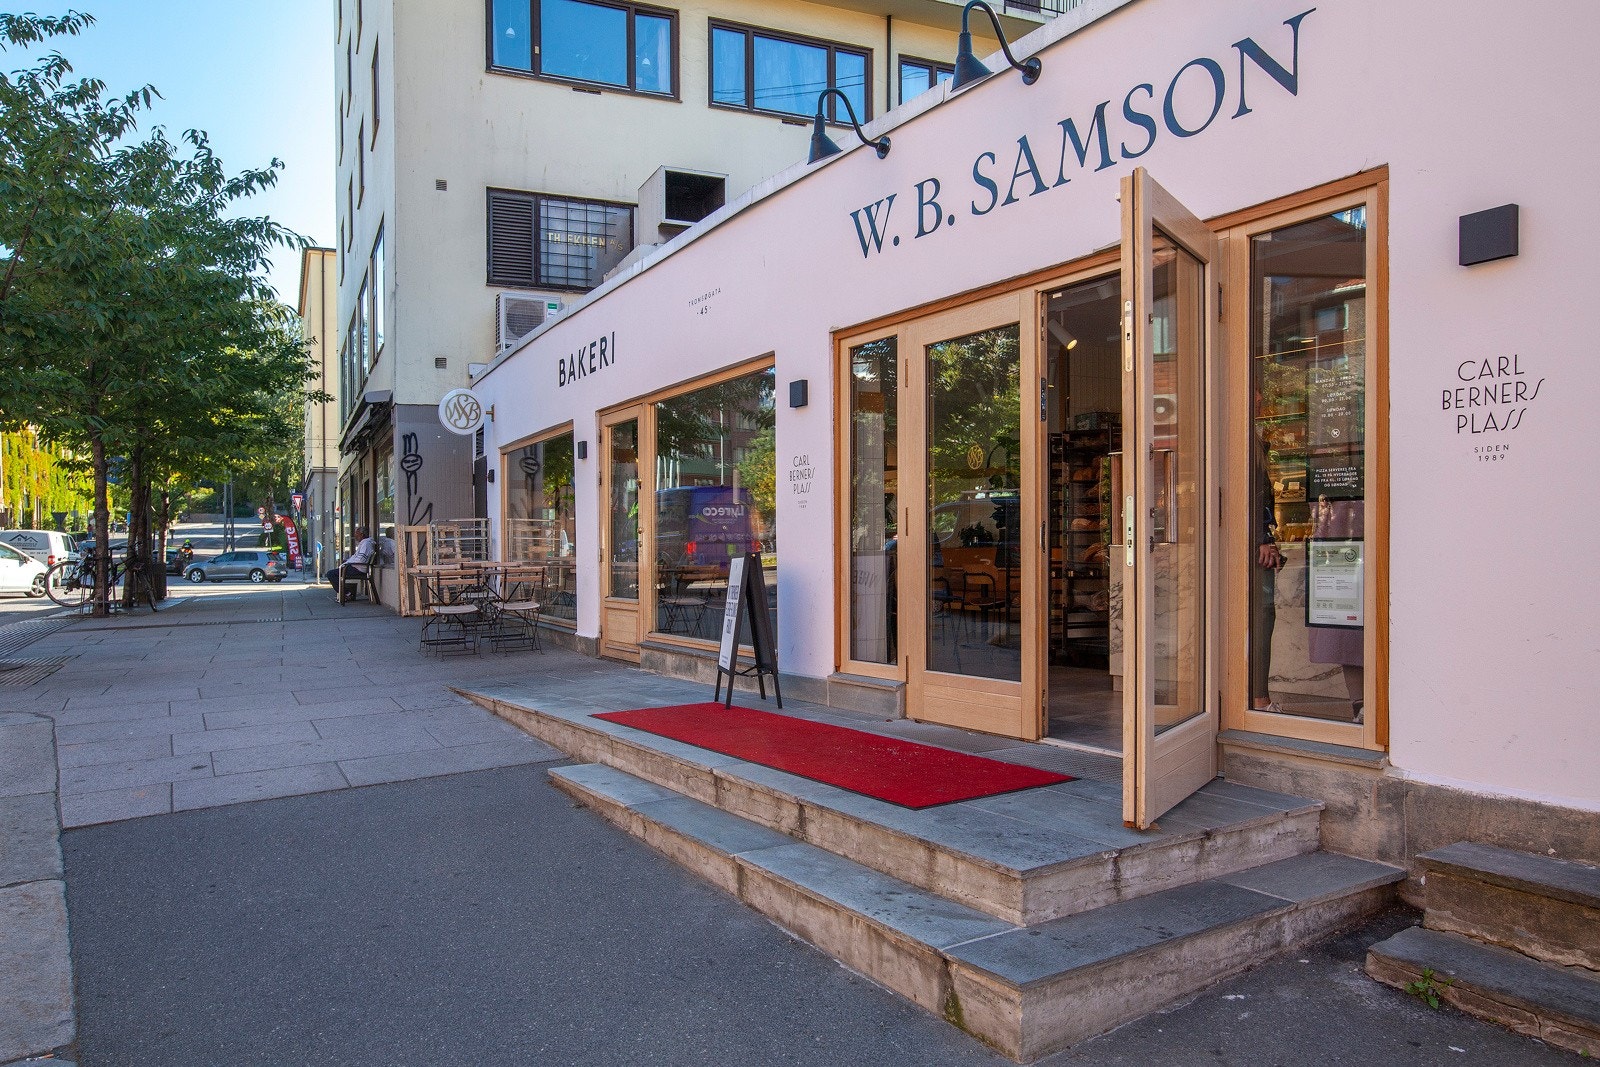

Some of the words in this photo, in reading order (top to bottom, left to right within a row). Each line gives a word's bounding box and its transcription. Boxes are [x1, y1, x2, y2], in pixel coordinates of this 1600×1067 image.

[849, 192, 901, 260] W.
[913, 176, 956, 240] B.
[971, 7, 1317, 216] SAMSON
[559, 331, 616, 388] BAKERI
[1457, 354, 1525, 382] CARL
[1442, 378, 1545, 411] BERNERS
[1457, 408, 1527, 434] PLASS
[793, 454, 810, 468] CARL
[1474, 444, 1510, 454] SIDEN
[1478, 453, 1505, 462] 1989
